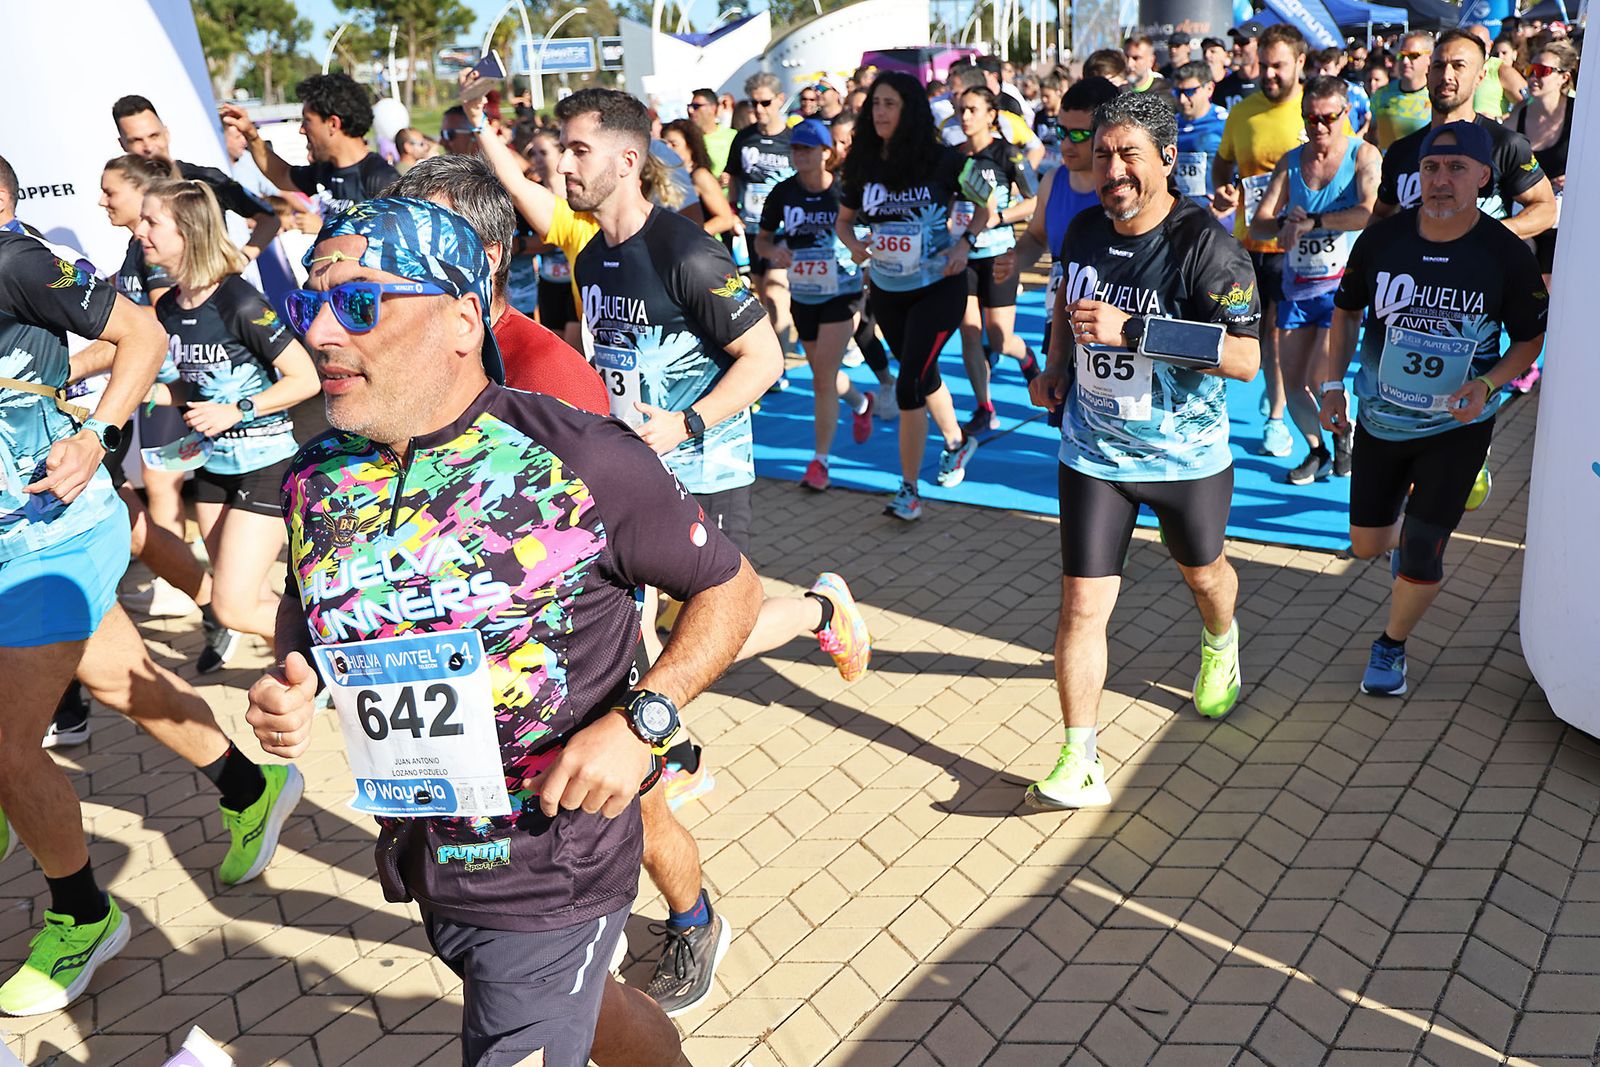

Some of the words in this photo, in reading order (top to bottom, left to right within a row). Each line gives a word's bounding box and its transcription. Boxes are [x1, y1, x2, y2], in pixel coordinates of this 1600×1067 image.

[18, 183, 75, 200] OPPER
[804, 212, 837, 224] HUELV
[876, 236, 911, 252] 366
[1298, 238, 1335, 255] 503
[793, 261, 828, 275] 473
[1093, 281, 1160, 314] HUELVA
[1375, 271, 1415, 325] 10
[1411, 285, 1484, 313] HUELVA
[600, 295, 649, 325] HUELVA
[1400, 316, 1448, 331] AVATE
[180, 343, 230, 364] HUELVA
[1452, 342, 1470, 353] '24
[617, 354, 634, 367] '24
[1402, 352, 1445, 378] 39
[301, 536, 476, 611] HUELVA
[308, 571, 511, 646] UNNERS
[349, 653, 382, 671] HUELVA
[385, 649, 437, 668] AVATEL
[356, 683, 465, 742] 642
[394, 757, 411, 765] JUAN
[411, 756, 440, 765] ANTONIO
[391, 768, 418, 777] LOZANO
[418, 767, 449, 776] POZUELO
